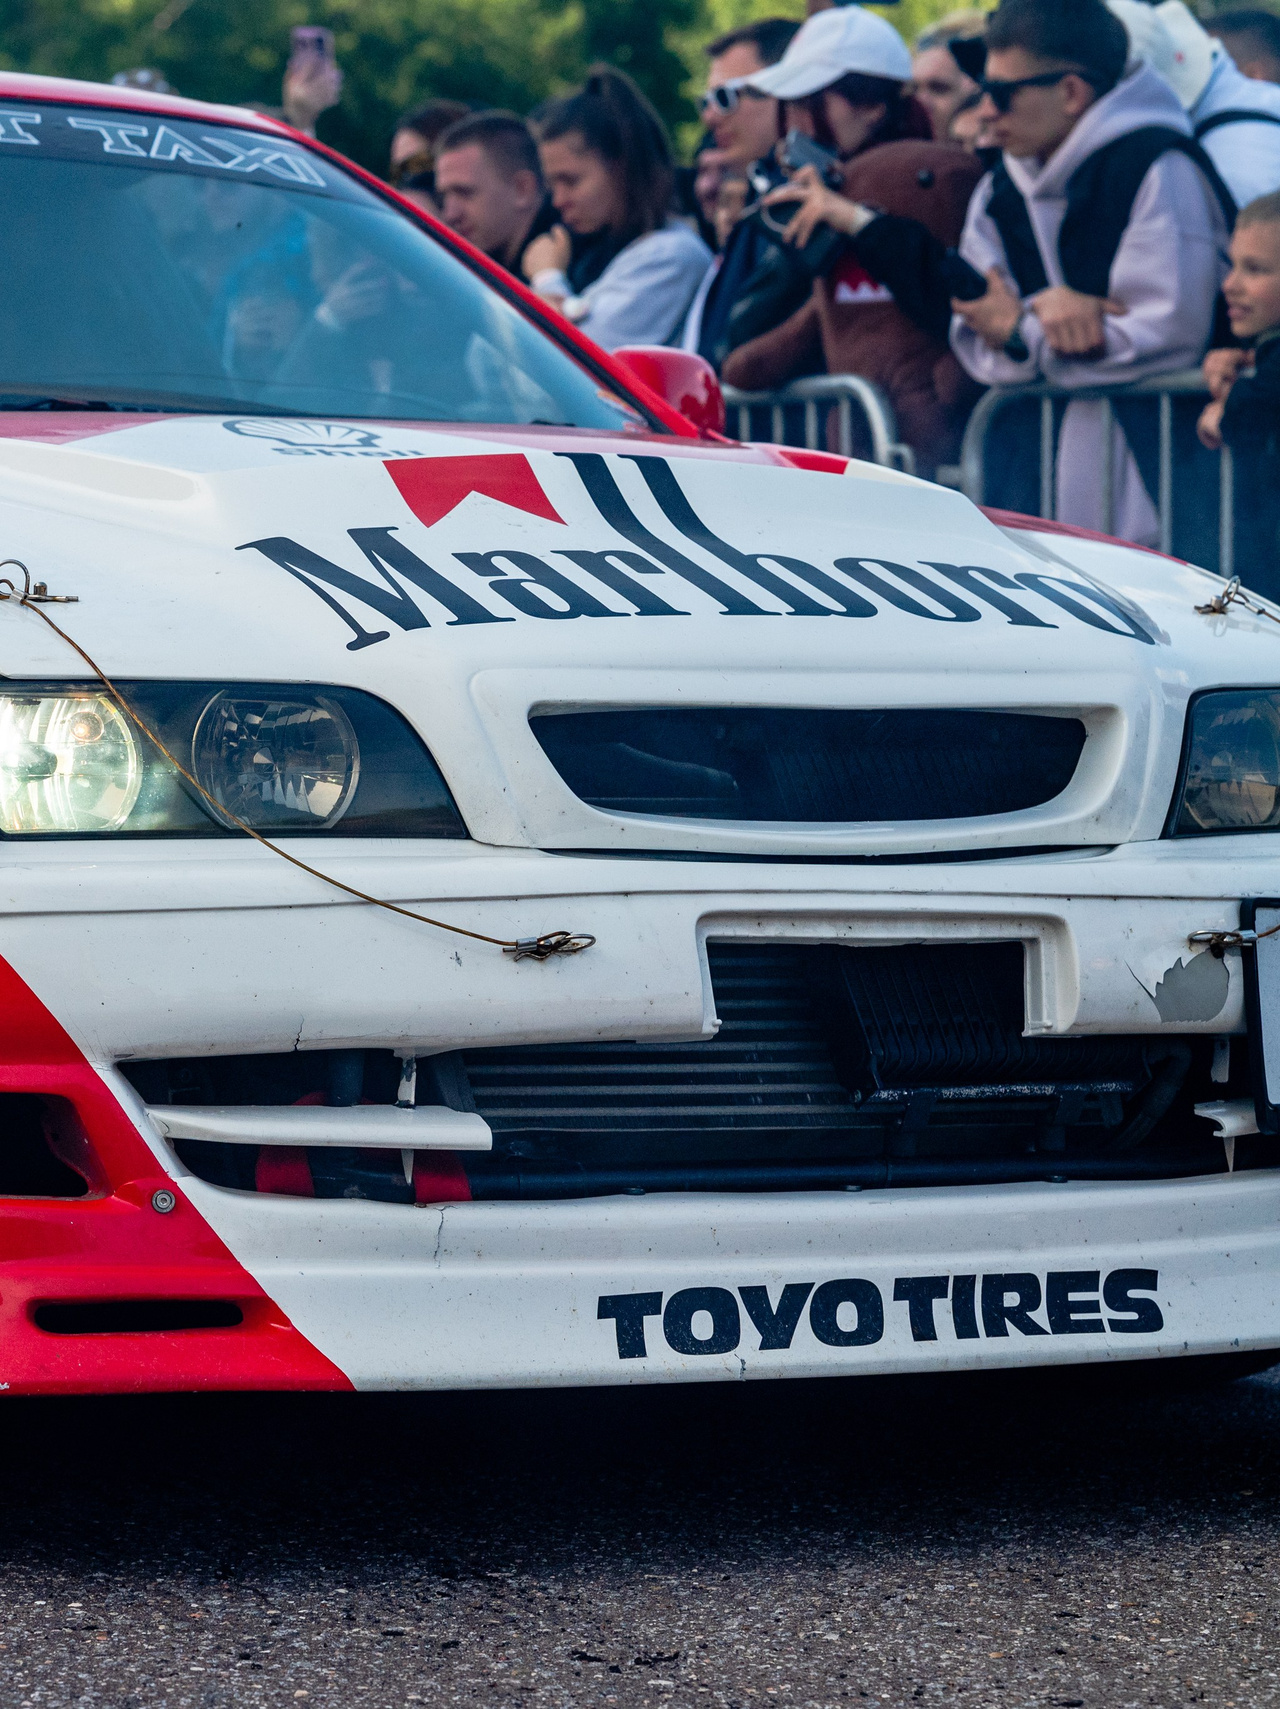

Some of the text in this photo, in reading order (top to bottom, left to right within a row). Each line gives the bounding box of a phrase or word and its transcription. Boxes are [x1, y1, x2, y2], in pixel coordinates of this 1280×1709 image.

[67, 116, 326, 188] TAXI
[235, 452, 1157, 652] Marlboro
[597, 1268, 1164, 1360] TOYO TIRES
